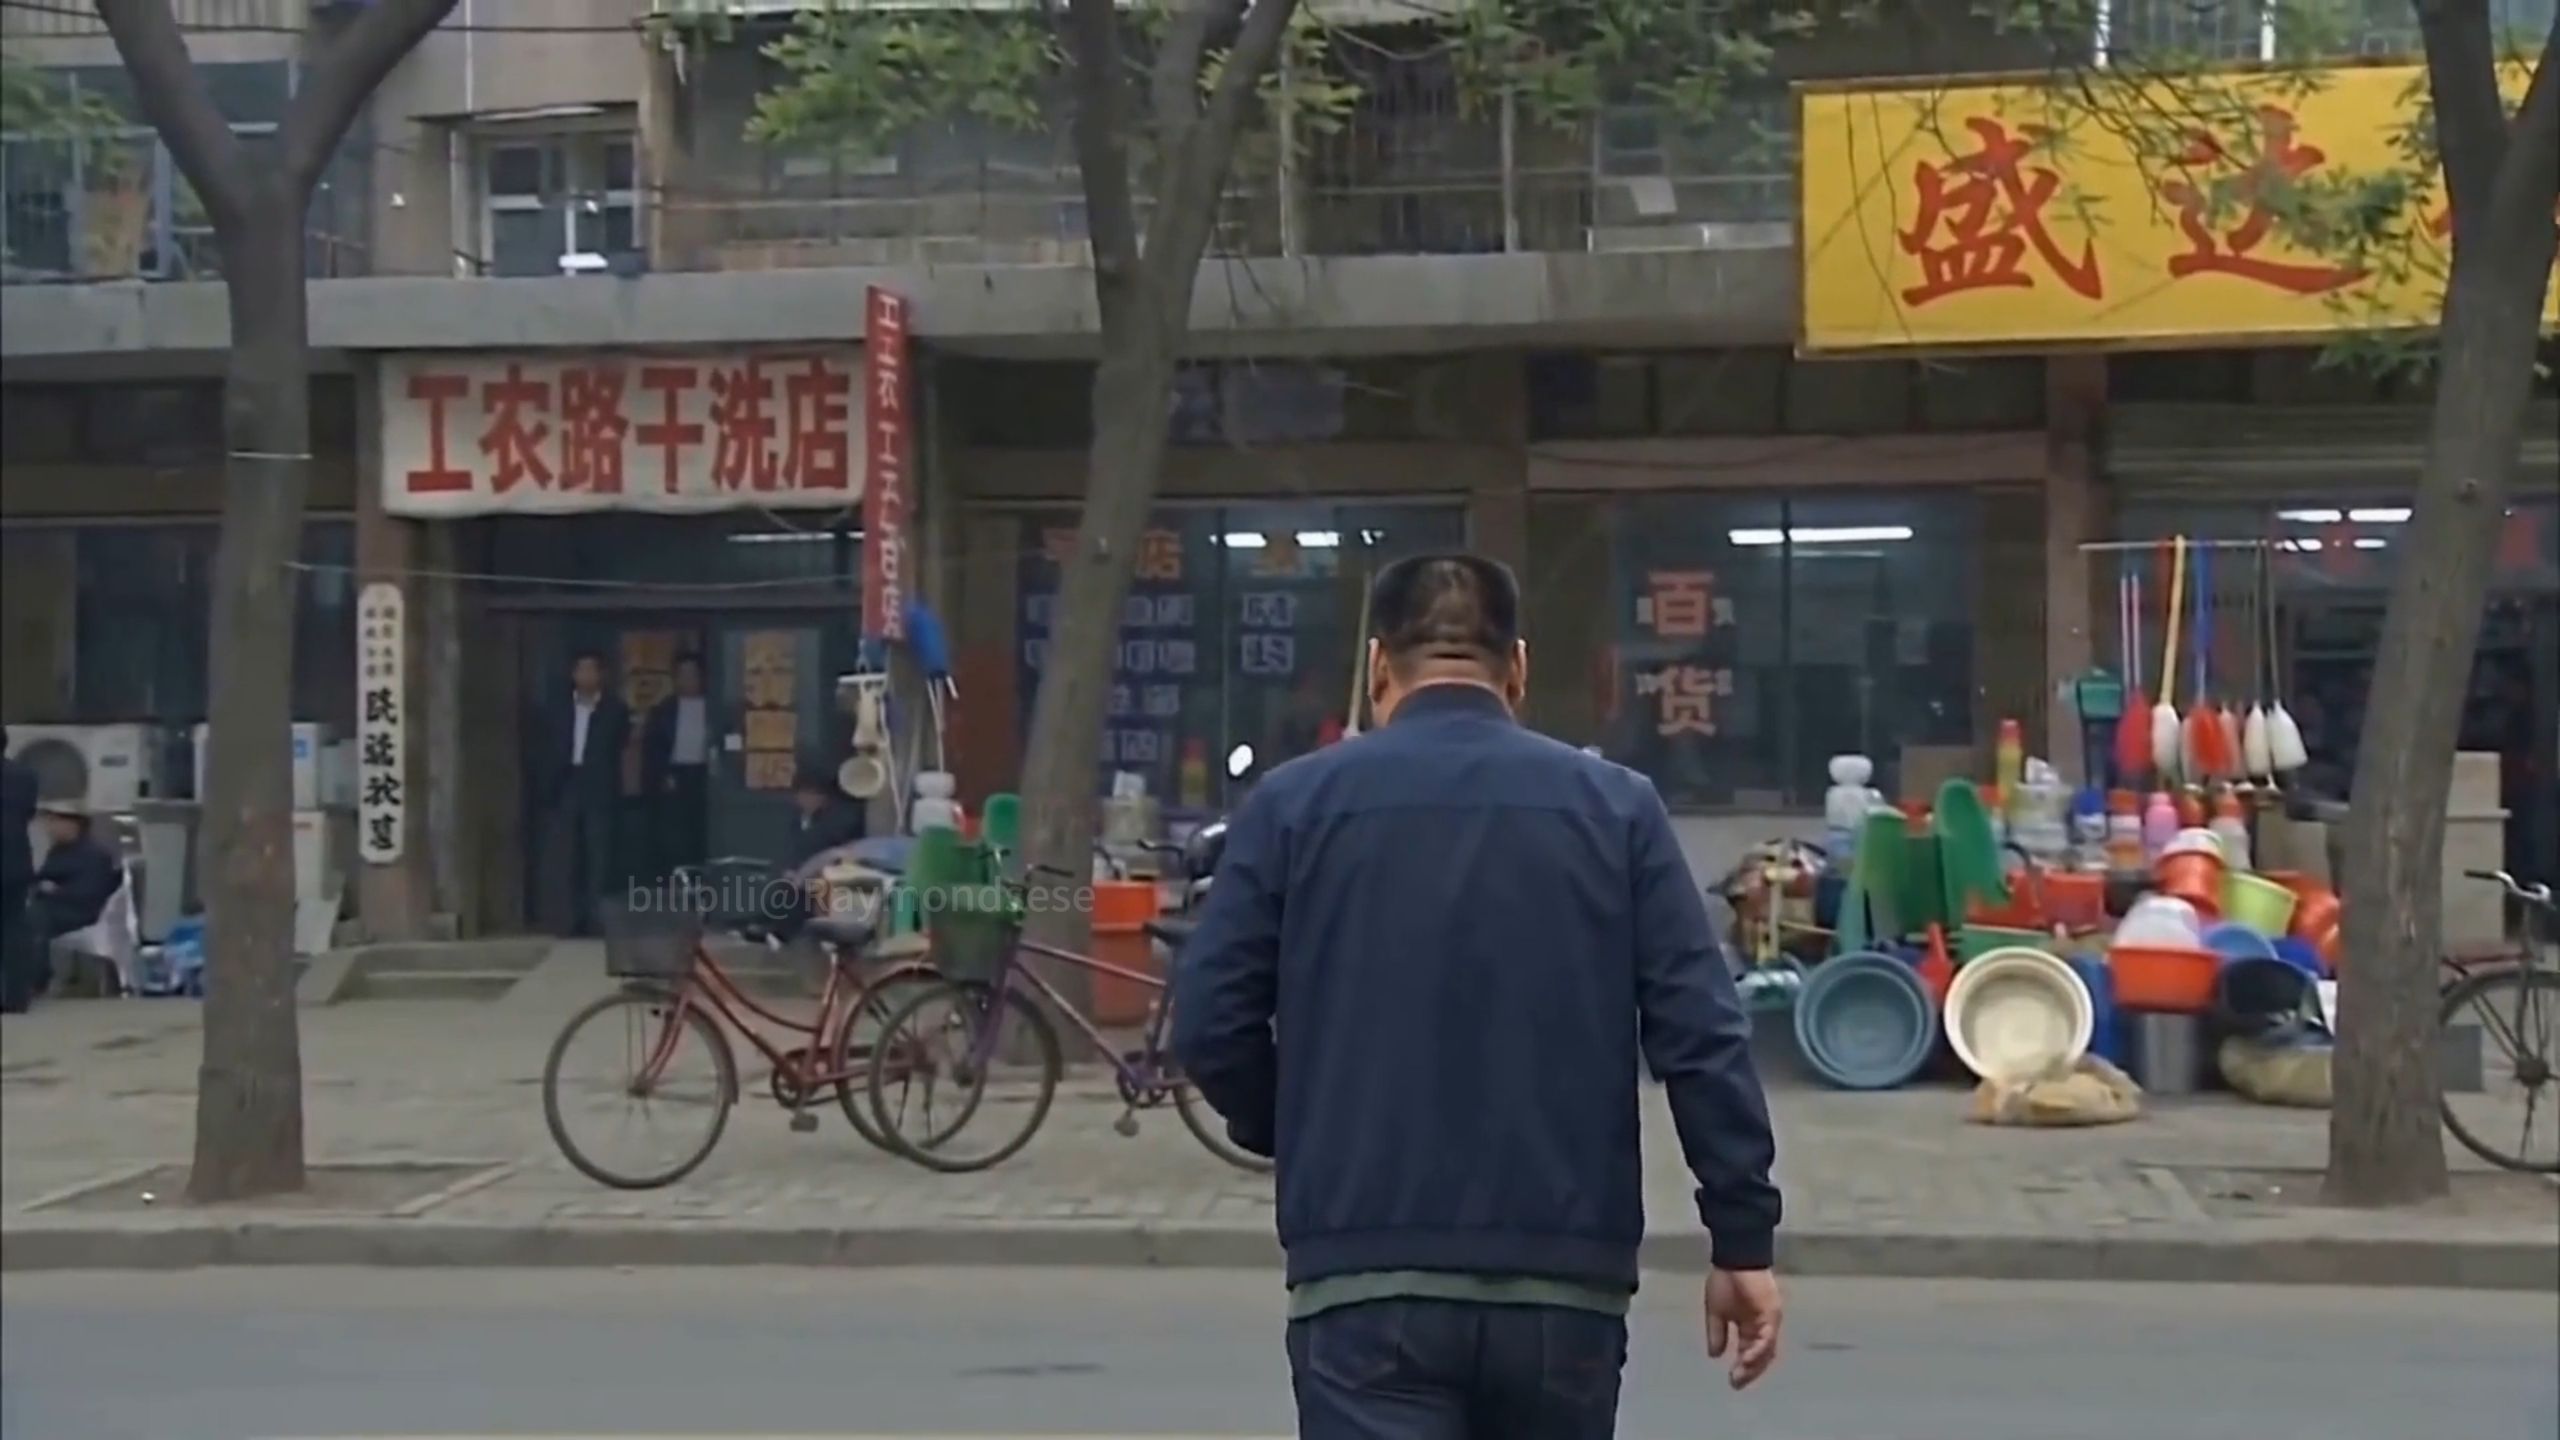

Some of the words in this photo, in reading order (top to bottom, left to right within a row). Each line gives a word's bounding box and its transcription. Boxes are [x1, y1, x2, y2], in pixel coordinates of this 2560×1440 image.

[405, 360, 851, 494] 工农路干洗店
